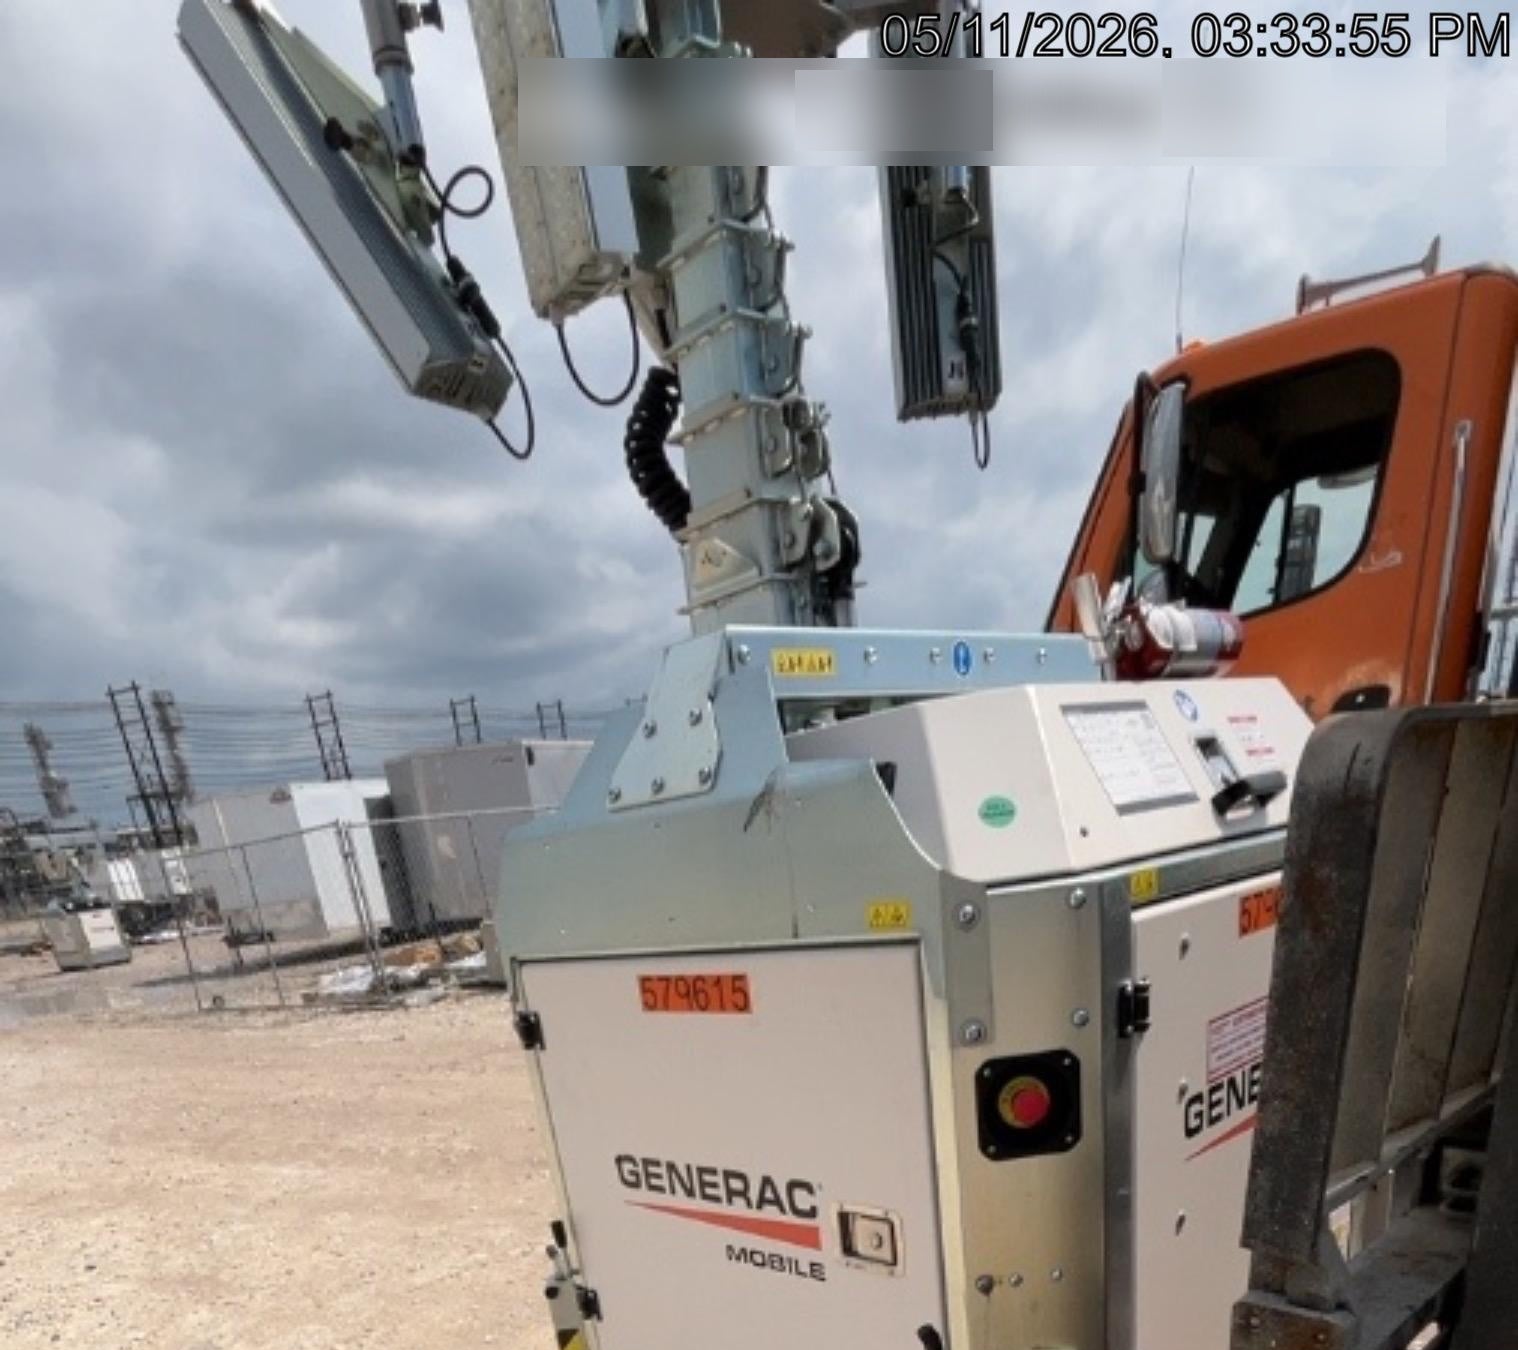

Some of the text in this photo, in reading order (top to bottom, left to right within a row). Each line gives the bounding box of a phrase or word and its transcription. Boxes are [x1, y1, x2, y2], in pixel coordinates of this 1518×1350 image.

[640, 975, 750, 1012] 579615
[1184, 1062, 1262, 1138] GENE
[614, 1154, 817, 1219] GENERAC
[725, 1244, 826, 1282] MOBILE
